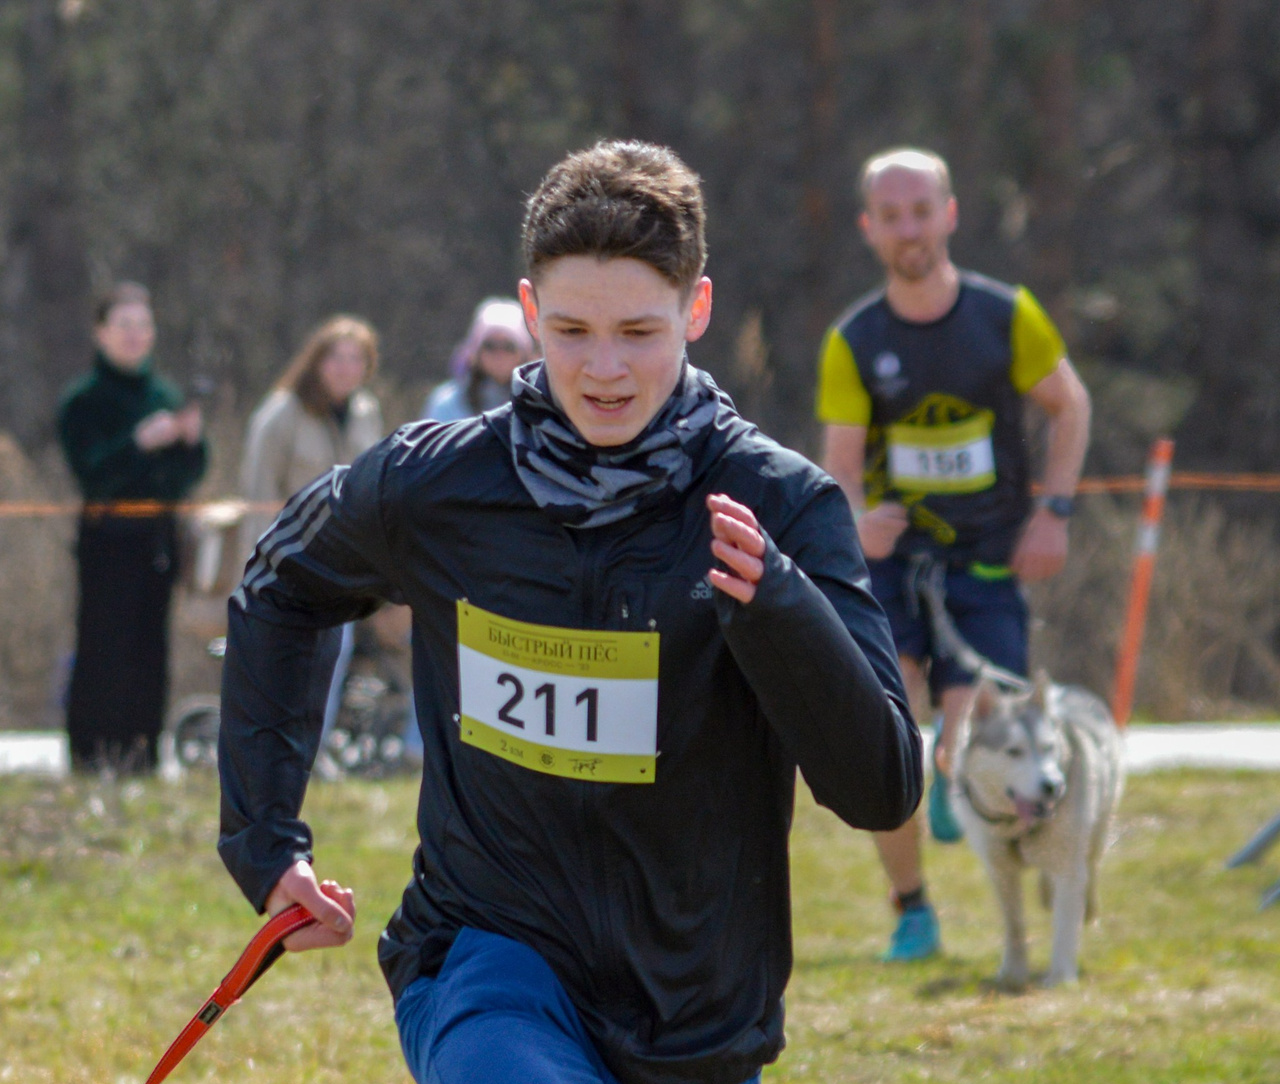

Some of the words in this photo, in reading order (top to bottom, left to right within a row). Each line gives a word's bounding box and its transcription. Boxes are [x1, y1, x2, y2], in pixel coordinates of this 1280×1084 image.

[488, 627, 573, 660] БЫСТРЫЙ
[579, 643, 618, 662] ПЁС
[496, 672, 600, 742] 211
